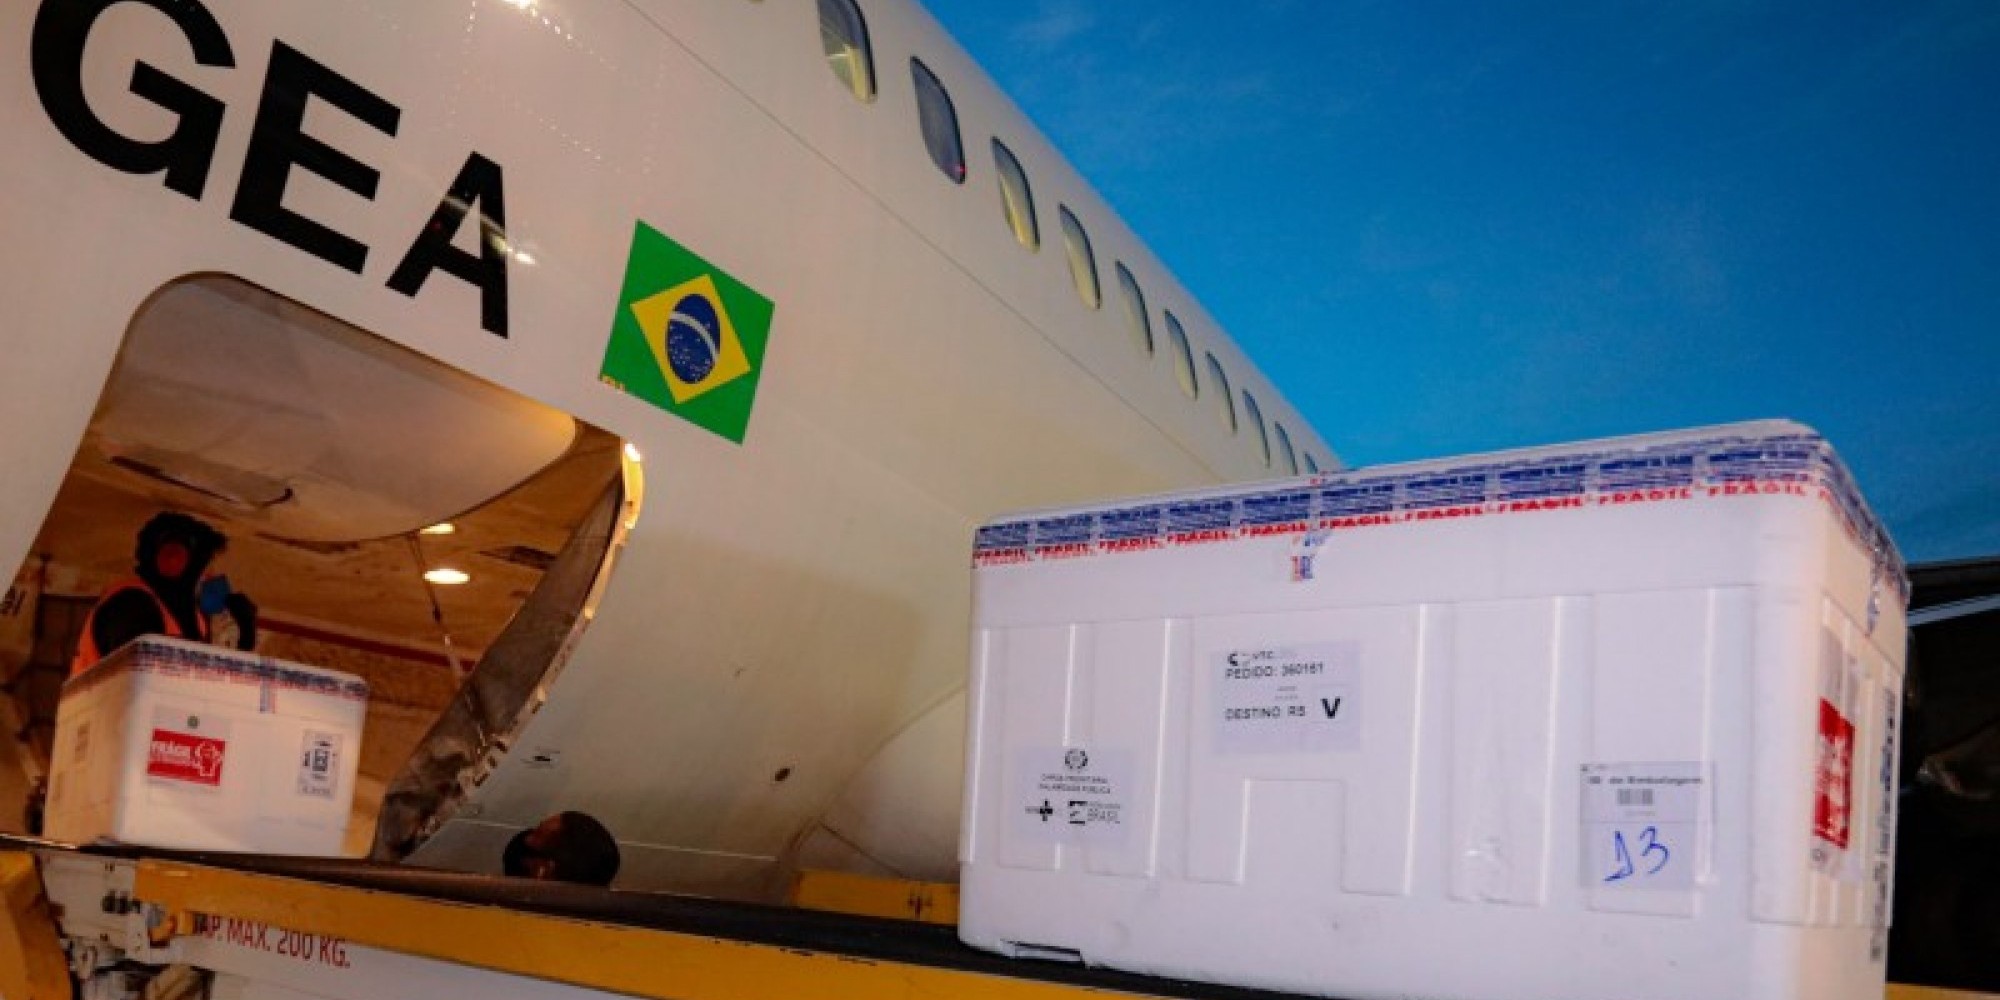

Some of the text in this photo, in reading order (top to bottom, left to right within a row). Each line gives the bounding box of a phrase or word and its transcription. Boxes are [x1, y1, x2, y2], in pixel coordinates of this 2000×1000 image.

[30, 0, 511, 340] GEA
[1320, 697, 1341, 719] V
[226, 917, 271, 952] MAX.
[277, 928, 313, 961] 200
[319, 935, 350, 969] KG.
